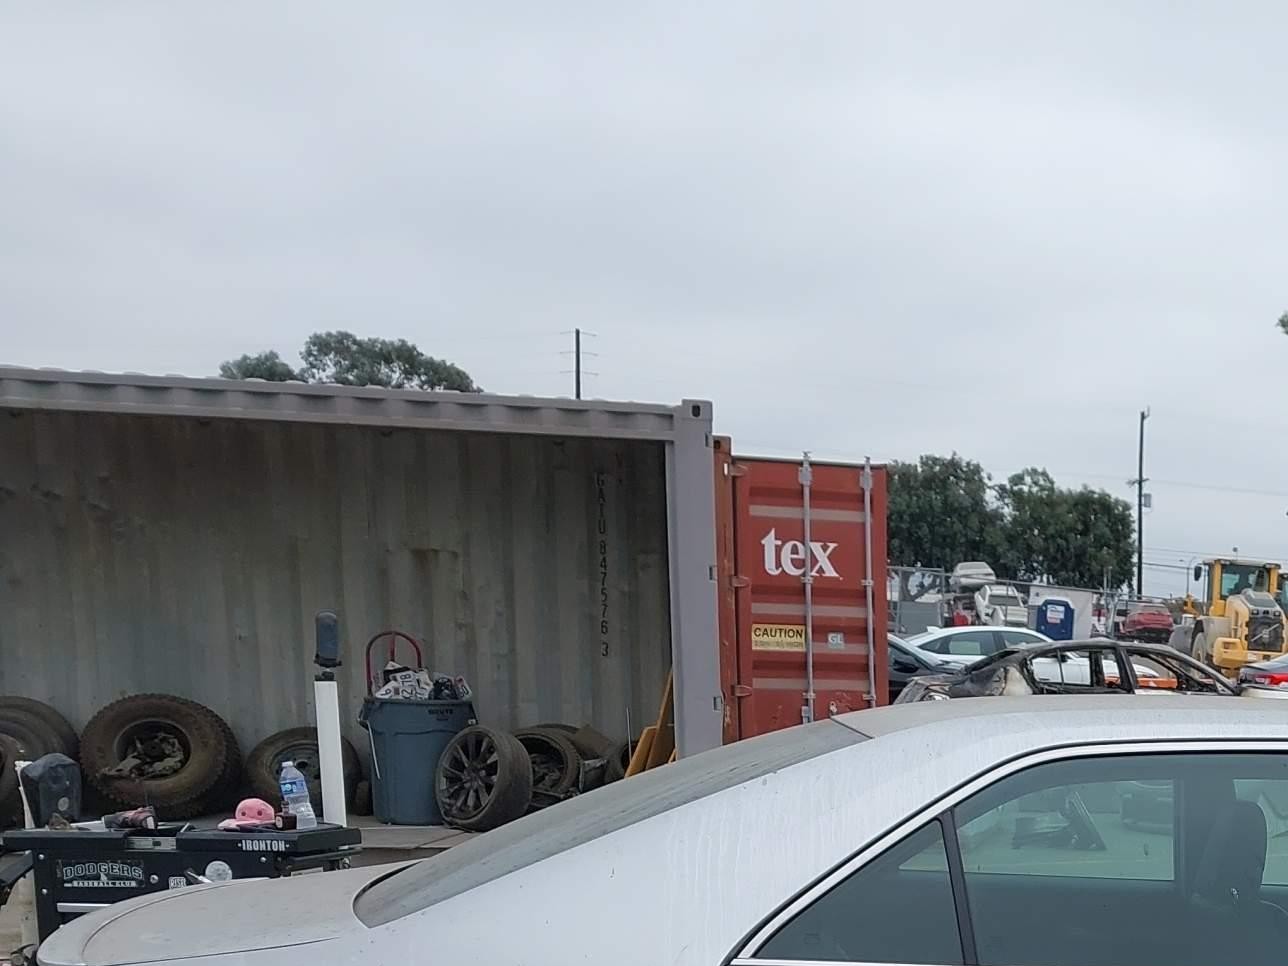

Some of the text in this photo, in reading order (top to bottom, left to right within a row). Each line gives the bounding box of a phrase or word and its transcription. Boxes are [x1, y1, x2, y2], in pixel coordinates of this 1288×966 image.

[761, 528, 840, 577] tex
[753, 628, 803, 639] CAUTION
[602, 642, 608, 656] 3
[242, 839, 286, 851] IRONTON
[63, 863, 142, 879] DODGERS
